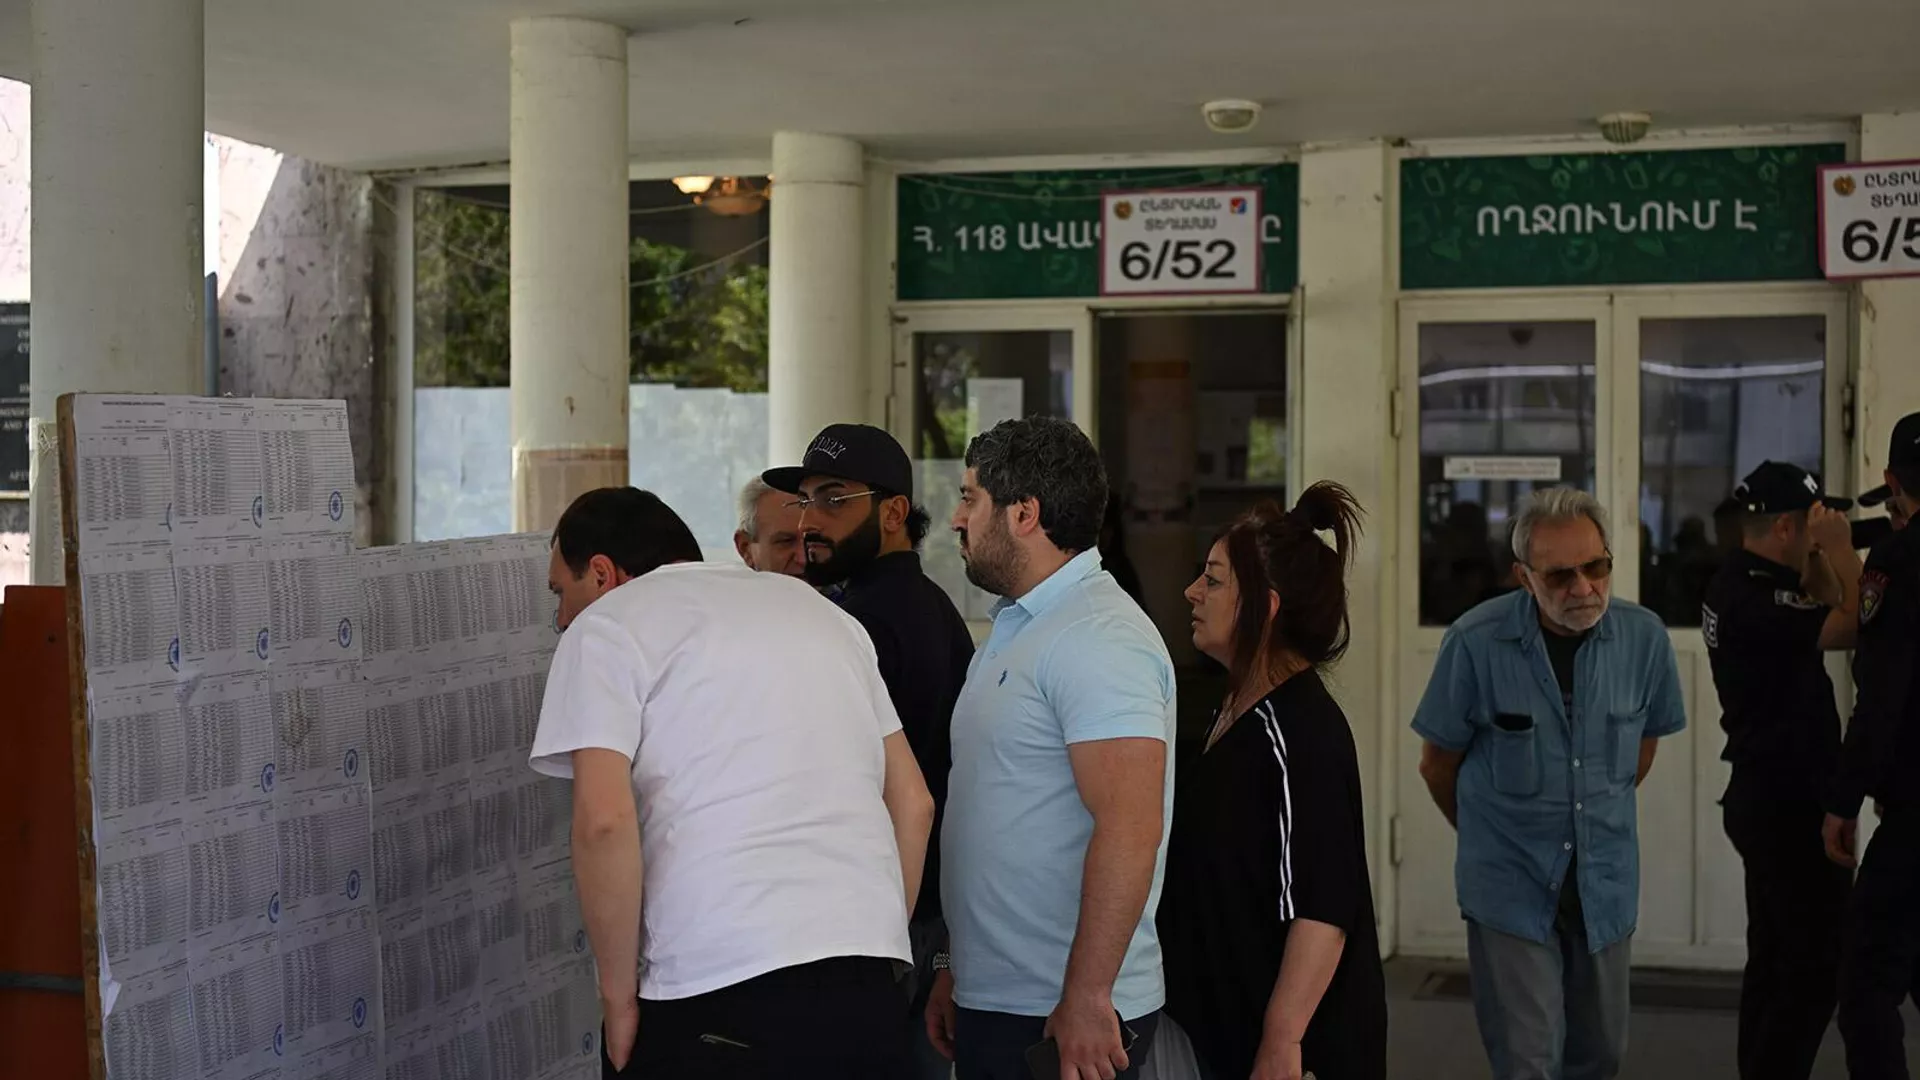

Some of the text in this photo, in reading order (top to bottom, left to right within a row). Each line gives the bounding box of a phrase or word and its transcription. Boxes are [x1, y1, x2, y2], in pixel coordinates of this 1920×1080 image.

[1477, 199, 1768, 236] ՈՂՋՈՒՆՈՒՄ Է
[1870, 192, 1920, 209] ՏԵՂԱ
[955, 224, 1007, 251] 118
[1017, 220, 1101, 250] ԱՎԱ
[1119, 239, 1236, 281] 6/52
